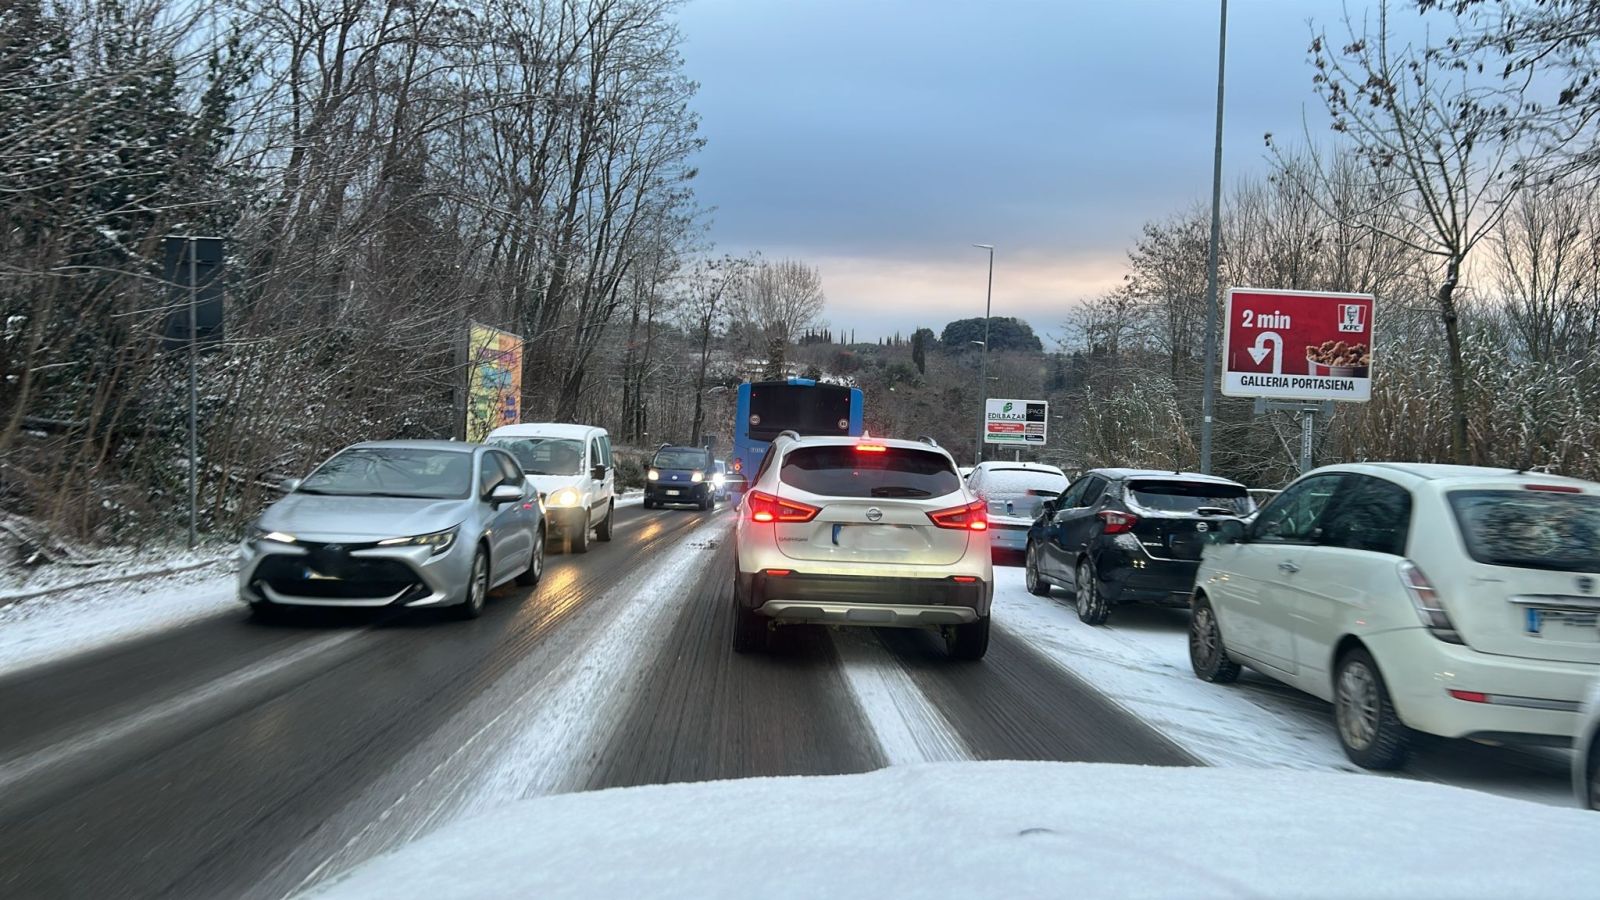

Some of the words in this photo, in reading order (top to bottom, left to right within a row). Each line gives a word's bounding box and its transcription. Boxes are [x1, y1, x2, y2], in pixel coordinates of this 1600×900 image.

[1241, 309, 1254, 328] 2
[1257, 310, 1291, 329] min
[1240, 375, 1289, 388] GALLERIA
[1291, 377, 1355, 391] PORTASIENA
